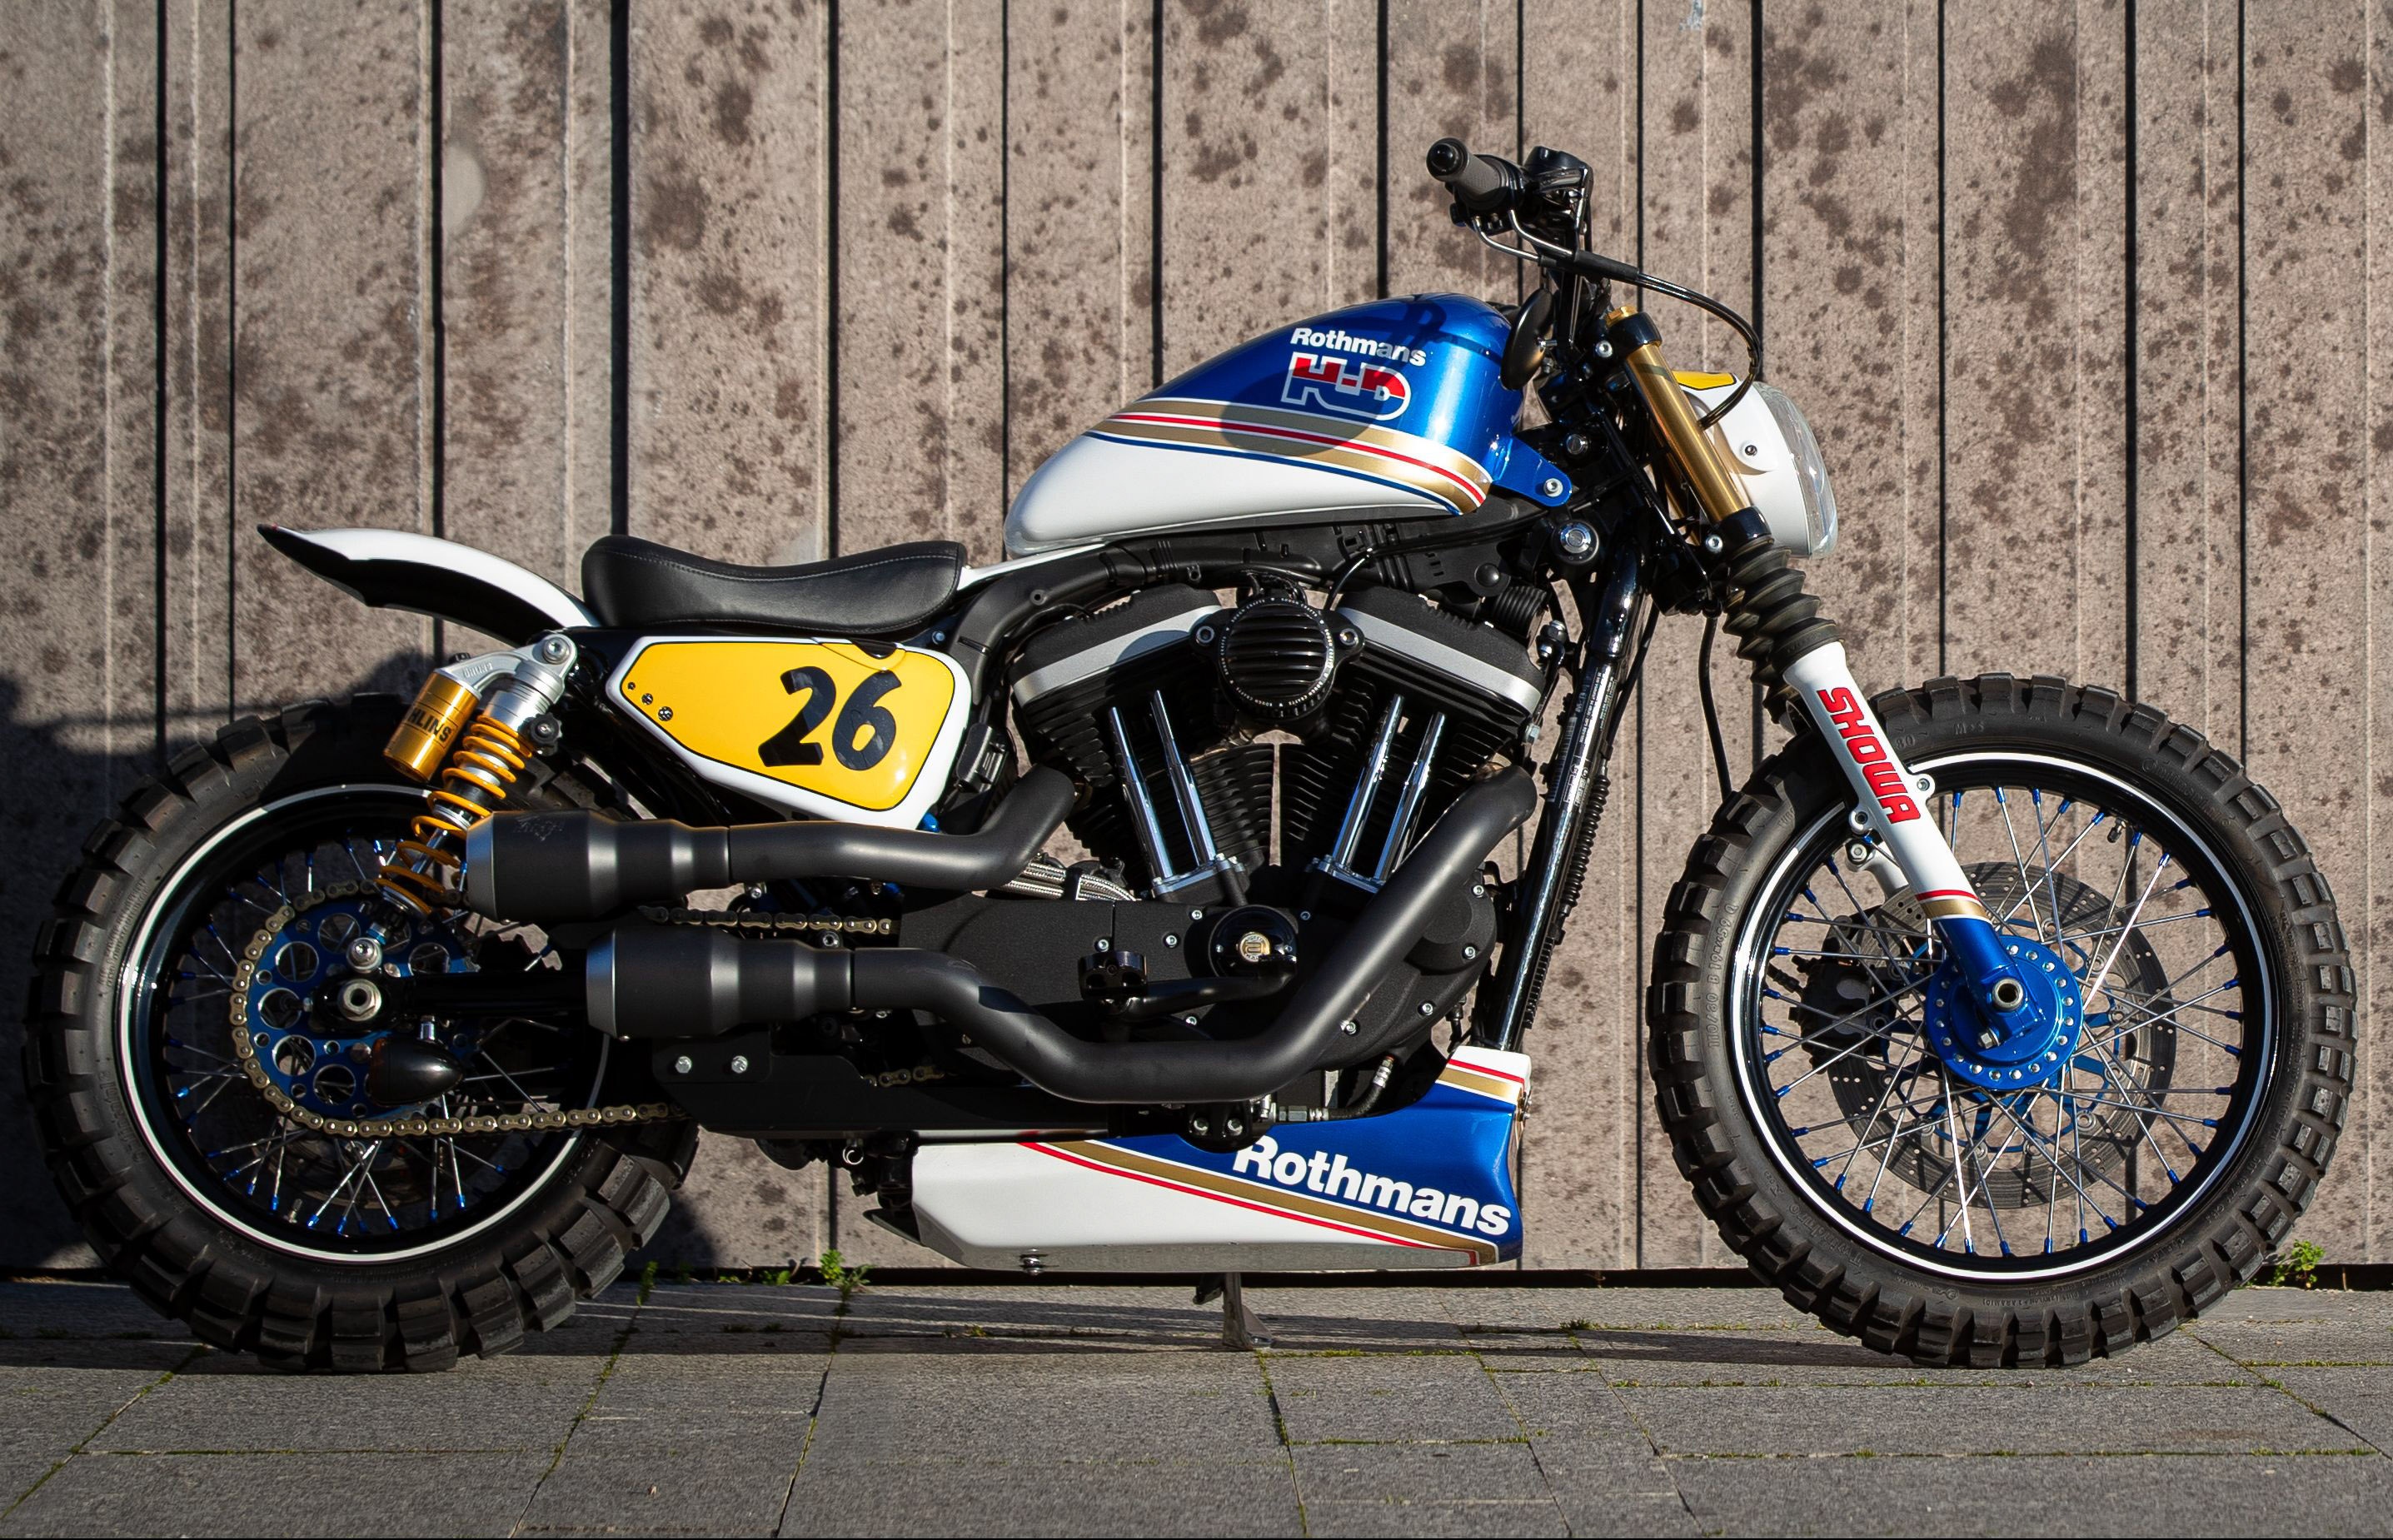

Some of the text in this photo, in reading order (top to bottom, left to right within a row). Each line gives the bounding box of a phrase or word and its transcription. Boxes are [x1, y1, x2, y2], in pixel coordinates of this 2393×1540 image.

[1290, 327, 1426, 366] Rothmans
[758, 666, 901, 771] 26
[1817, 687, 1922, 824] SHOWA
[1705, 973, 1720, 985] B
[1721, 900, 1739, 916] Q
[1232, 1135, 1512, 1235] Rothmans
